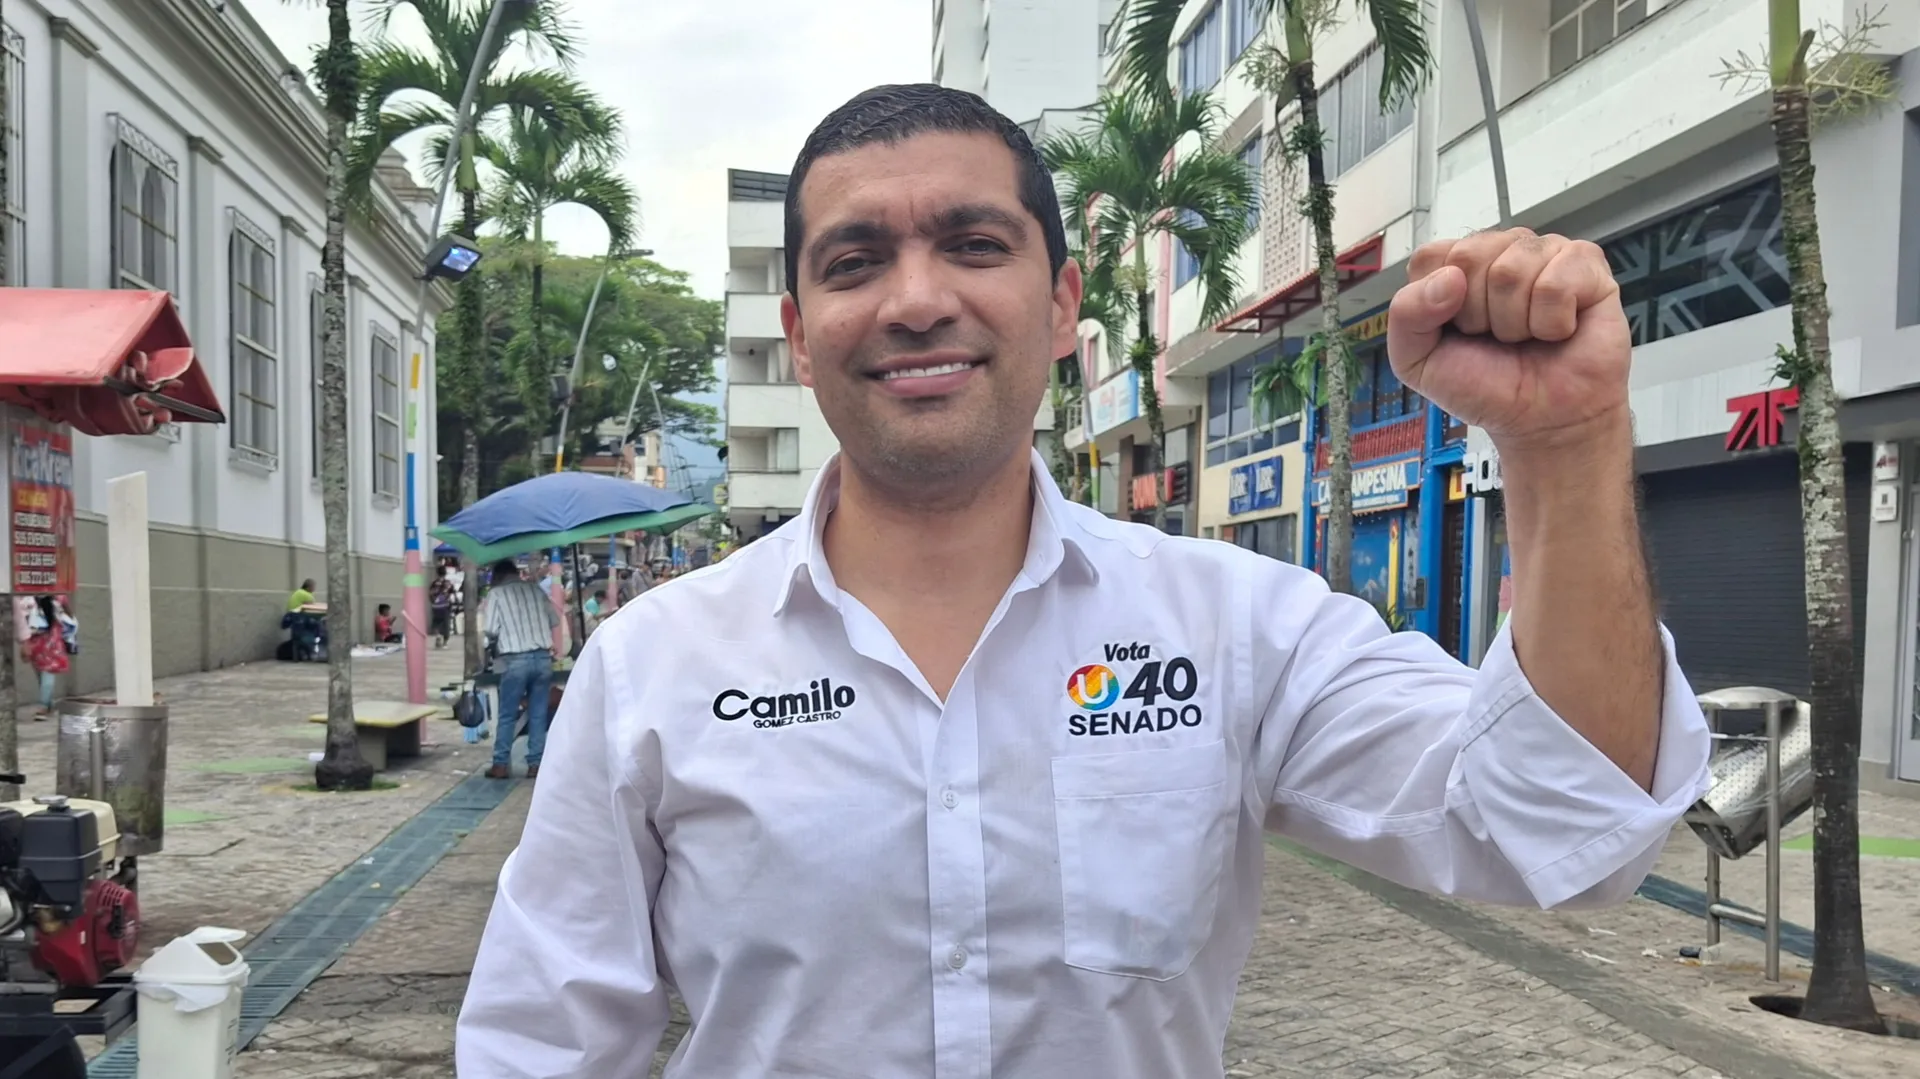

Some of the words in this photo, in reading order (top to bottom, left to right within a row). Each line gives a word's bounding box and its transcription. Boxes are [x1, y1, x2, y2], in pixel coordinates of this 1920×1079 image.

[1351, 462, 1407, 498] AMPESINA
[1104, 641, 1151, 662] Vota
[1122, 657, 1198, 707] 40
[713, 678, 856, 721] Camilo
[753, 716, 794, 728] GOMEZ
[797, 711, 841, 723] CASTRO
[1068, 704, 1202, 736] SENADO
